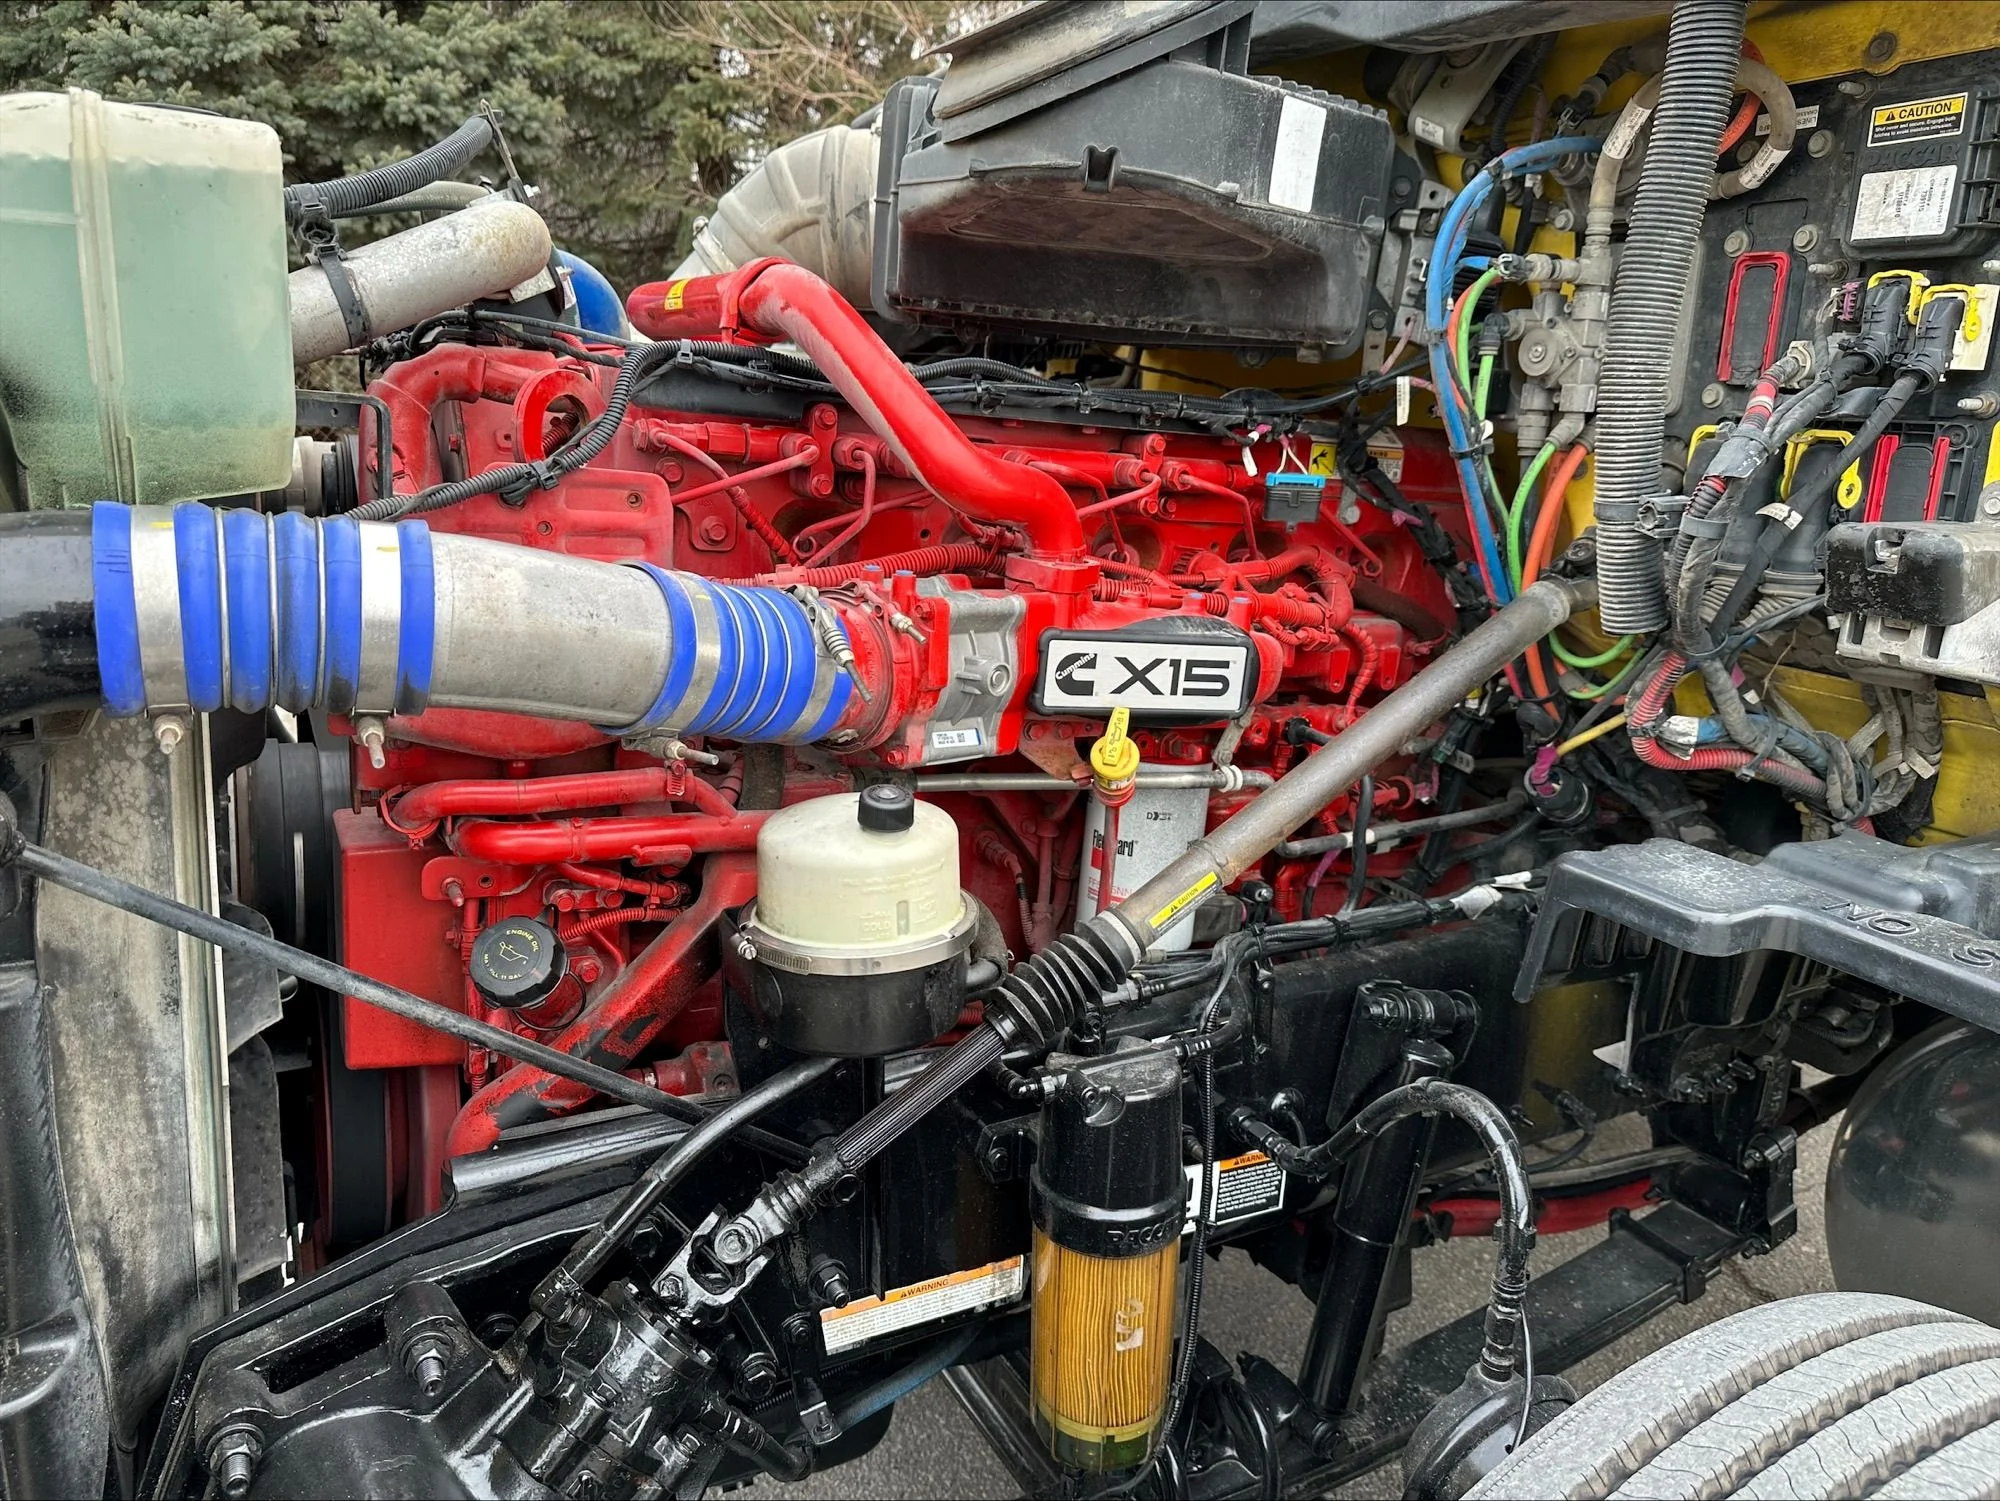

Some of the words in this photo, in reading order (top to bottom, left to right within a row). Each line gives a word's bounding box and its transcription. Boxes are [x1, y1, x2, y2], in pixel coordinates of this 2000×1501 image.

[1899, 102, 1952, 119] CAUTION
[1055, 652, 1096, 680] Cummins
[1109, 656, 1231, 697] X15
[1178, 888, 1199, 905] CAUTION
[1822, 902, 1920, 936] NO
[506, 929, 534, 941] ENGINE
[531, 940, 539, 952] OIL
[907, 1278, 949, 1298] WARNING
